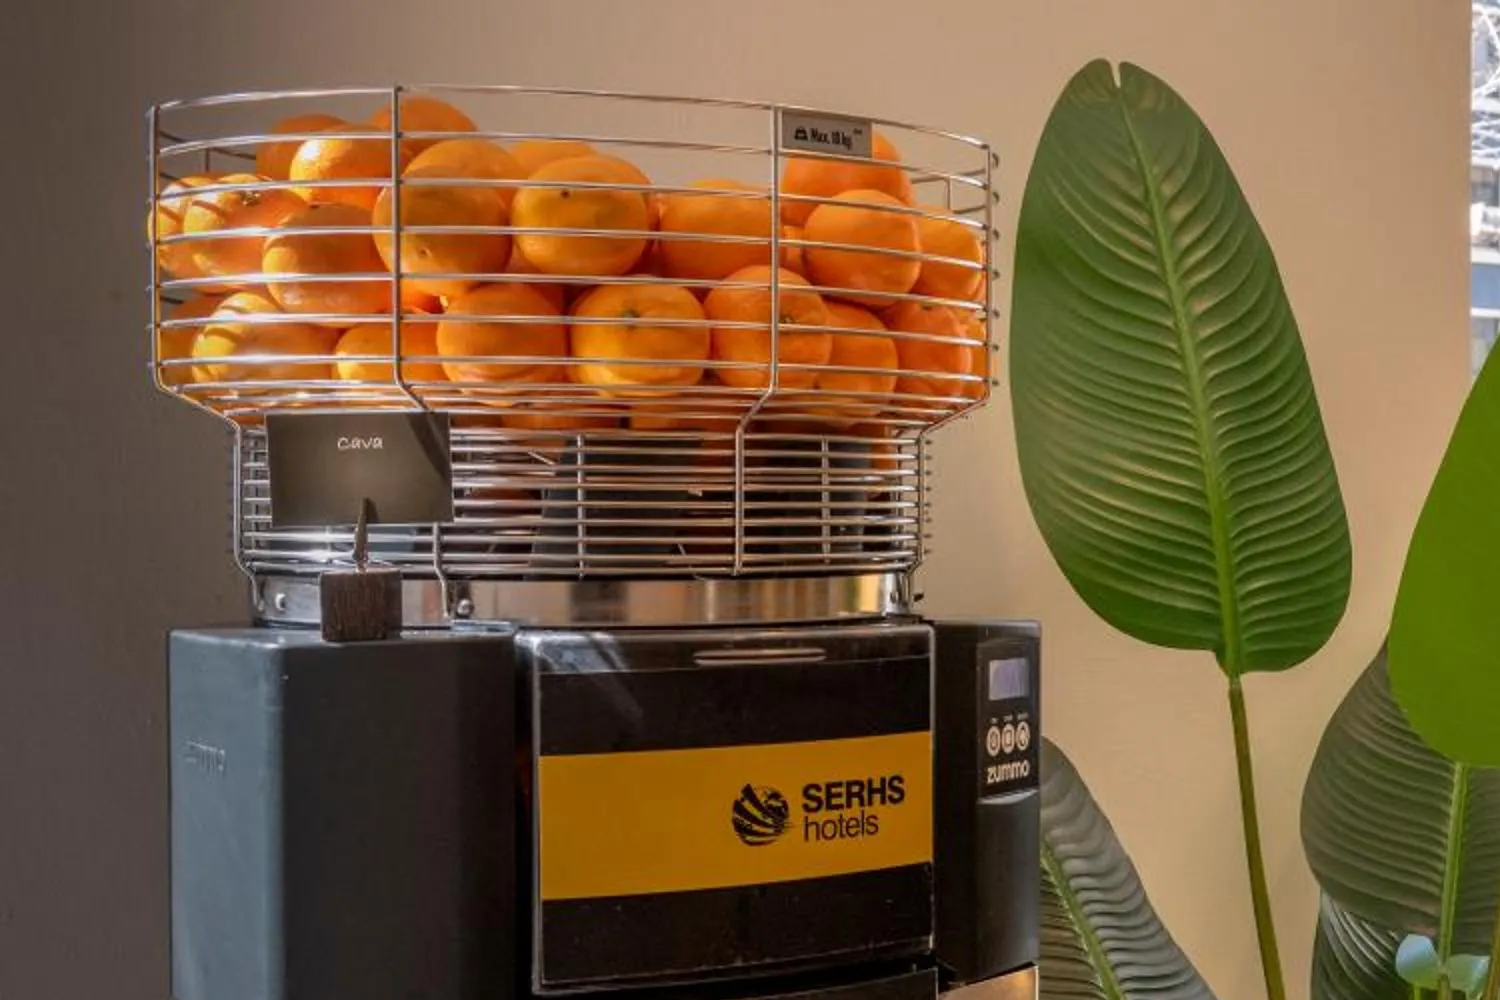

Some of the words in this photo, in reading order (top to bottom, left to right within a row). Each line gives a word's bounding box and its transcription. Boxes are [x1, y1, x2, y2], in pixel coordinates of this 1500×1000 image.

[986, 759, 1030, 784] zummo
[802, 774, 905, 813] SERHS
[803, 810, 880, 843] hotels
